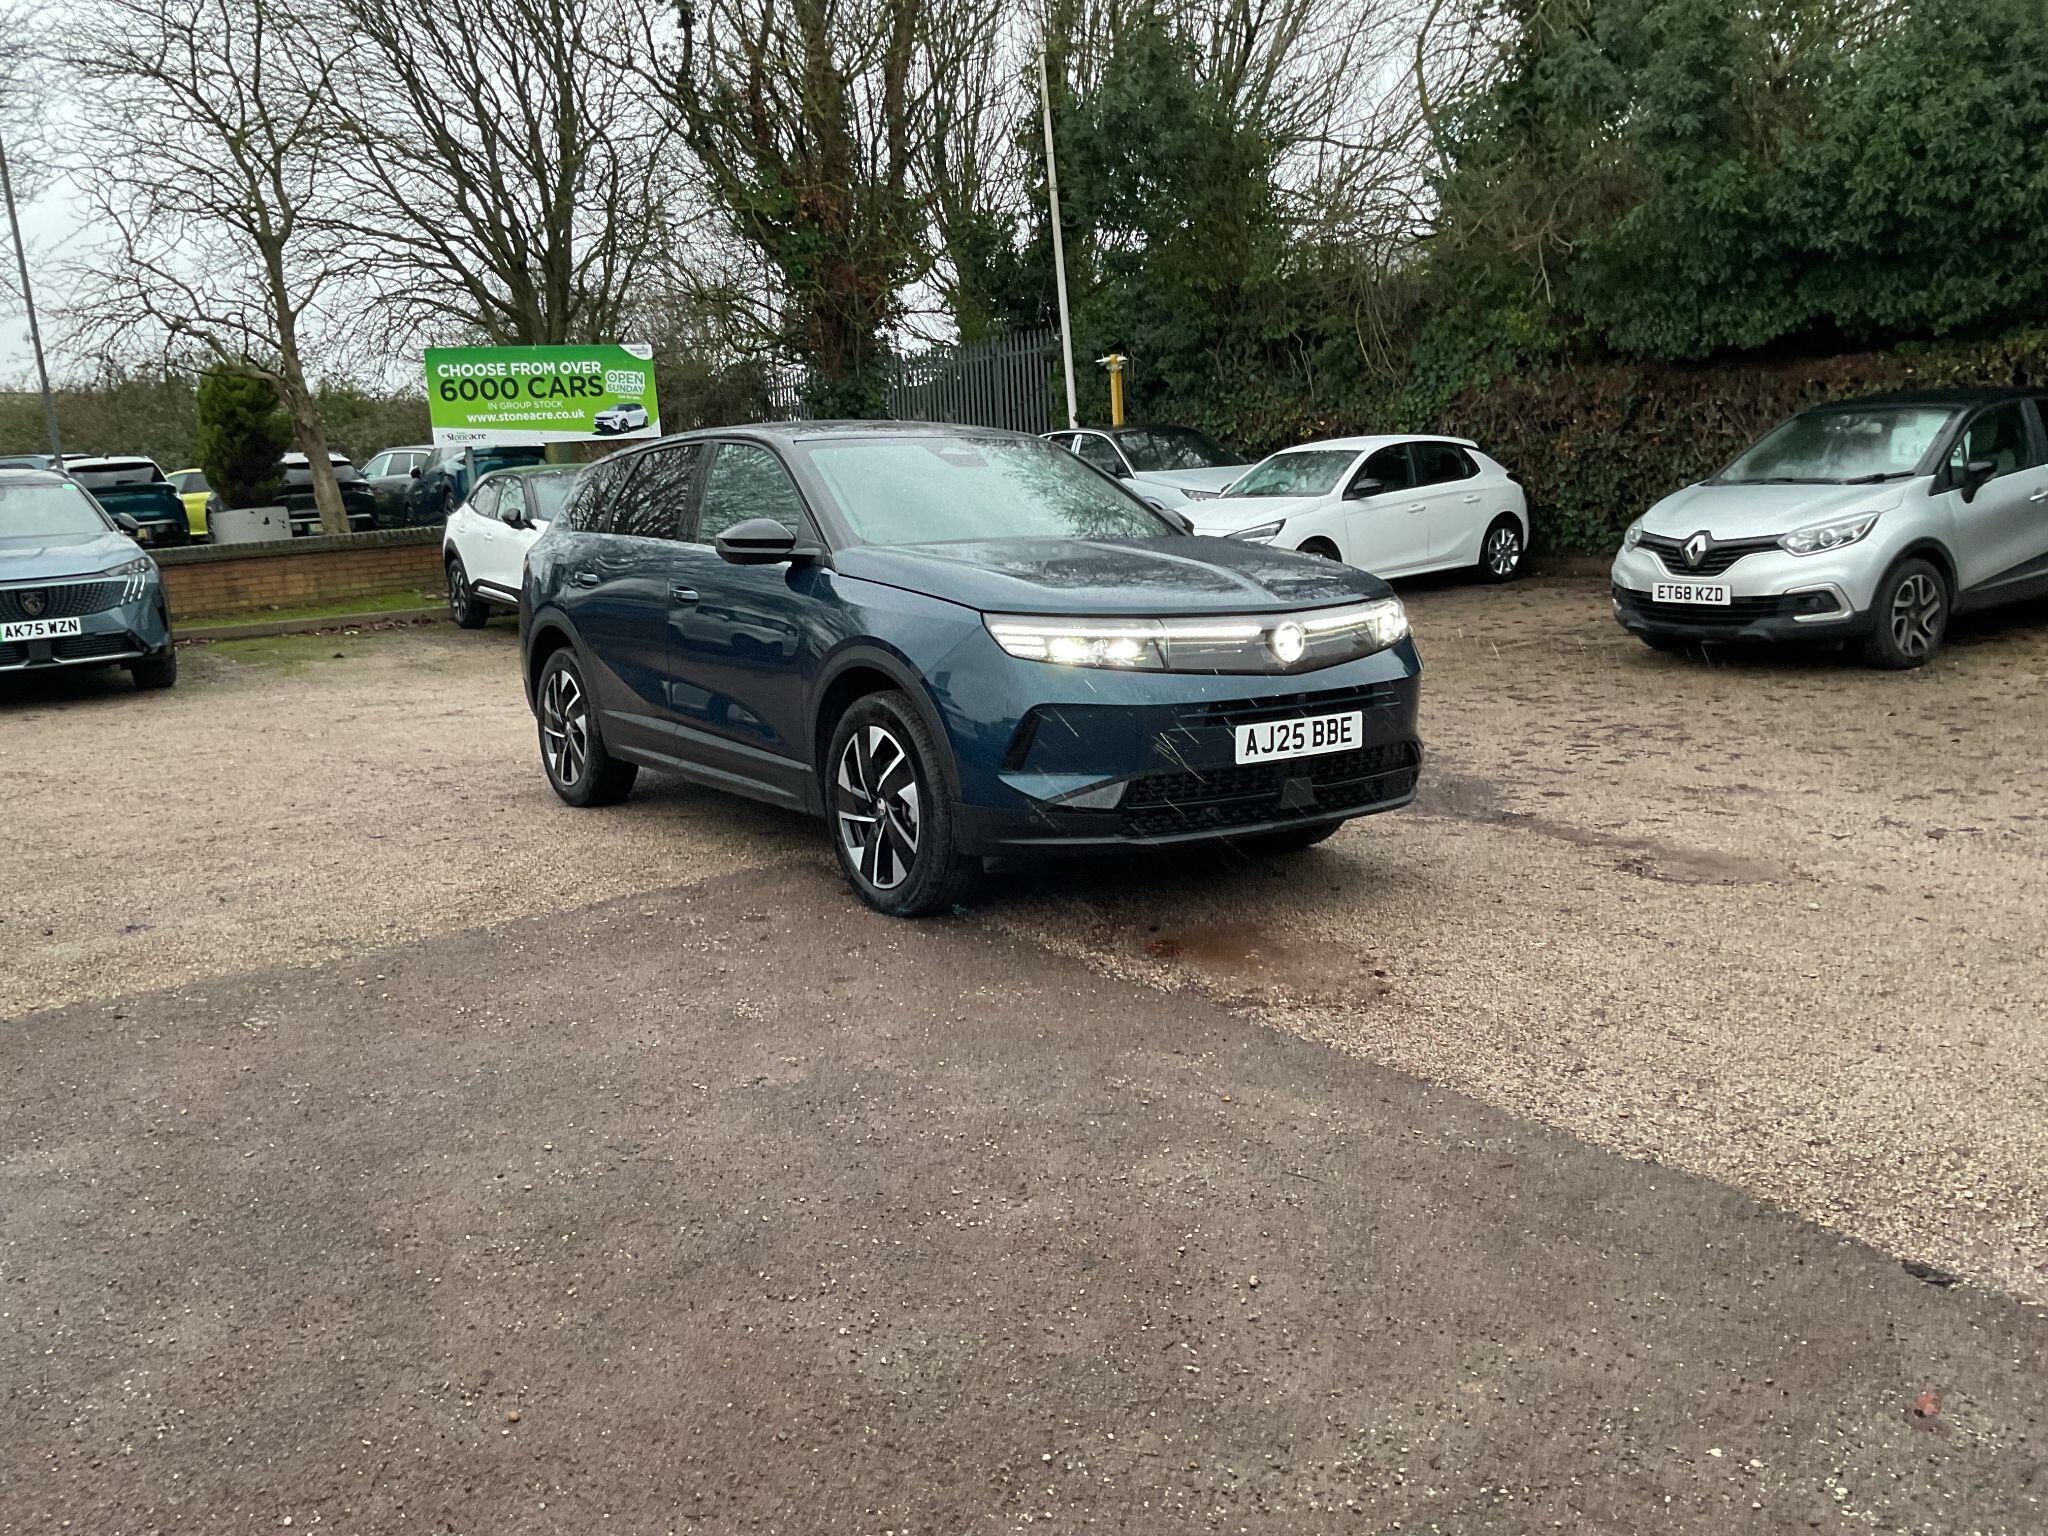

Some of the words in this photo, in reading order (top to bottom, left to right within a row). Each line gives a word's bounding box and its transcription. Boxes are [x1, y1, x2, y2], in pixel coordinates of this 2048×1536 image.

[437, 363, 507, 377] CHOOSE
[510, 362, 556, 376] FROM
[559, 361, 602, 375] OVER
[607, 371, 644, 385] OPEN
[440, 377, 519, 401] 6000
[527, 375, 604, 399] CARS
[607, 383, 645, 395] SUNDAY
[488, 402, 497, 410] IN
[500, 401, 531, 410] GROUP
[533, 400, 563, 409] STOCK
[467, 408, 585, 423] www.stoneacre.co.uk
[1657, 585, 1692, 600] ET68
[1696, 586, 1723, 602] KZD
[5, 623, 44, 638] AK75
[48, 620, 78, 633] WZN
[1245, 722, 1305, 755] AJ25
[1312, 716, 1353, 748] BBE
